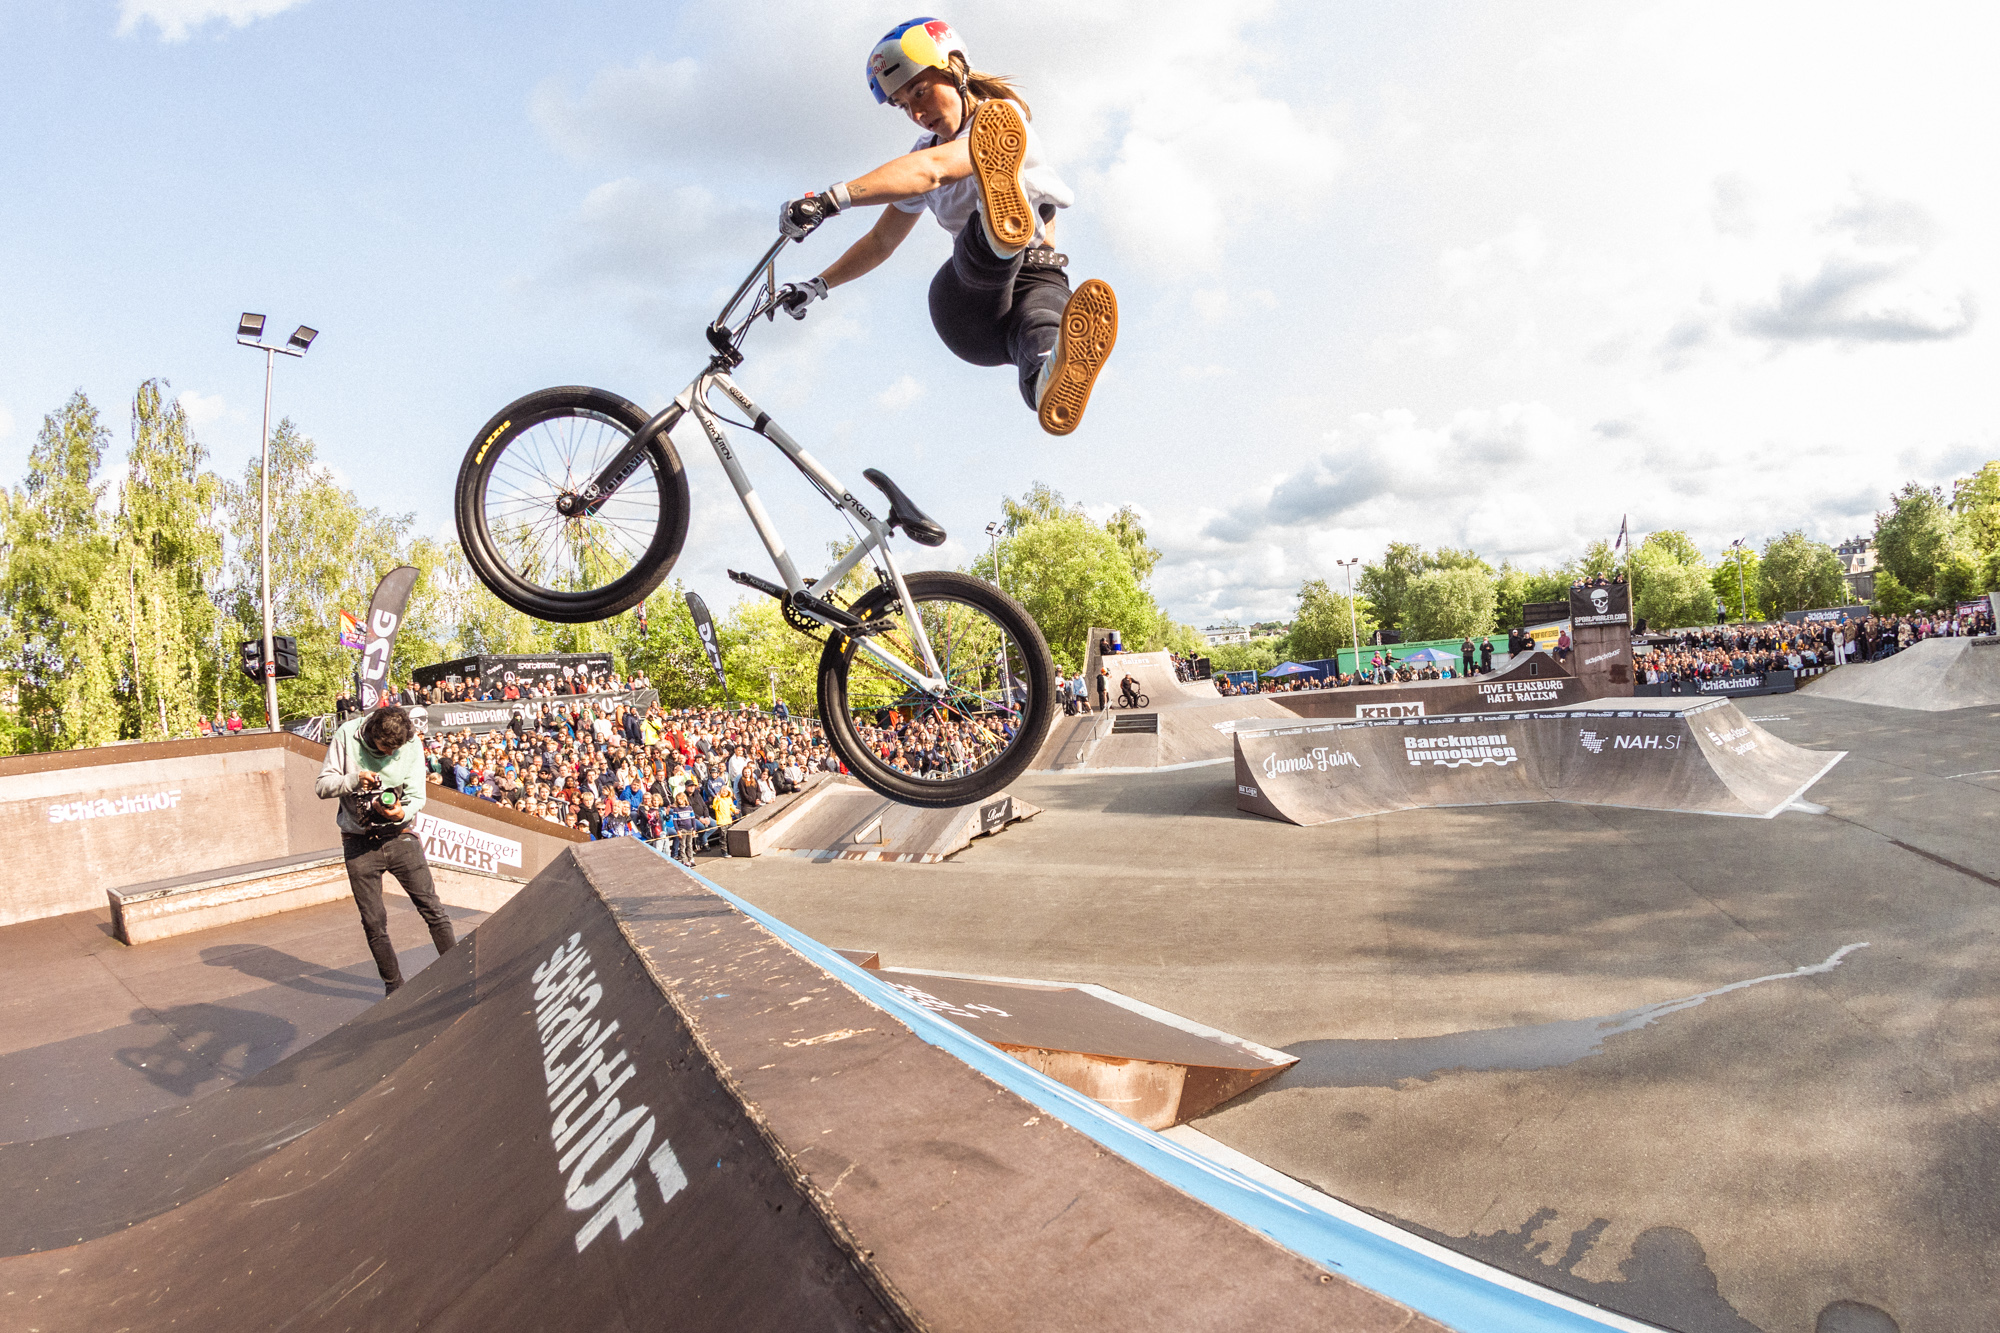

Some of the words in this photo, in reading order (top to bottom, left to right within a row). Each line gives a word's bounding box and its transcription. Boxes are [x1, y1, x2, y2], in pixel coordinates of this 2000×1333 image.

[475, 420, 511, 464] MAXXIS
[705, 420, 732, 460] DEMOLITION
[844, 493, 876, 521] OAKLEY
[1478, 684, 1505, 694] LOVE
[1506, 680, 1563, 692] FLENSBURG
[1487, 693, 1514, 703] HATE
[1515, 690, 1558, 702] RACISM
[441, 709, 511, 726] JUGENDPARK
[1613, 734, 1681, 750] NAH.SI
[1263, 752, 1314, 779] James
[1312, 747, 1361, 772] Farm
[1406, 747, 1517, 761] Immobilien
[420, 818, 518, 860] Flensburger
